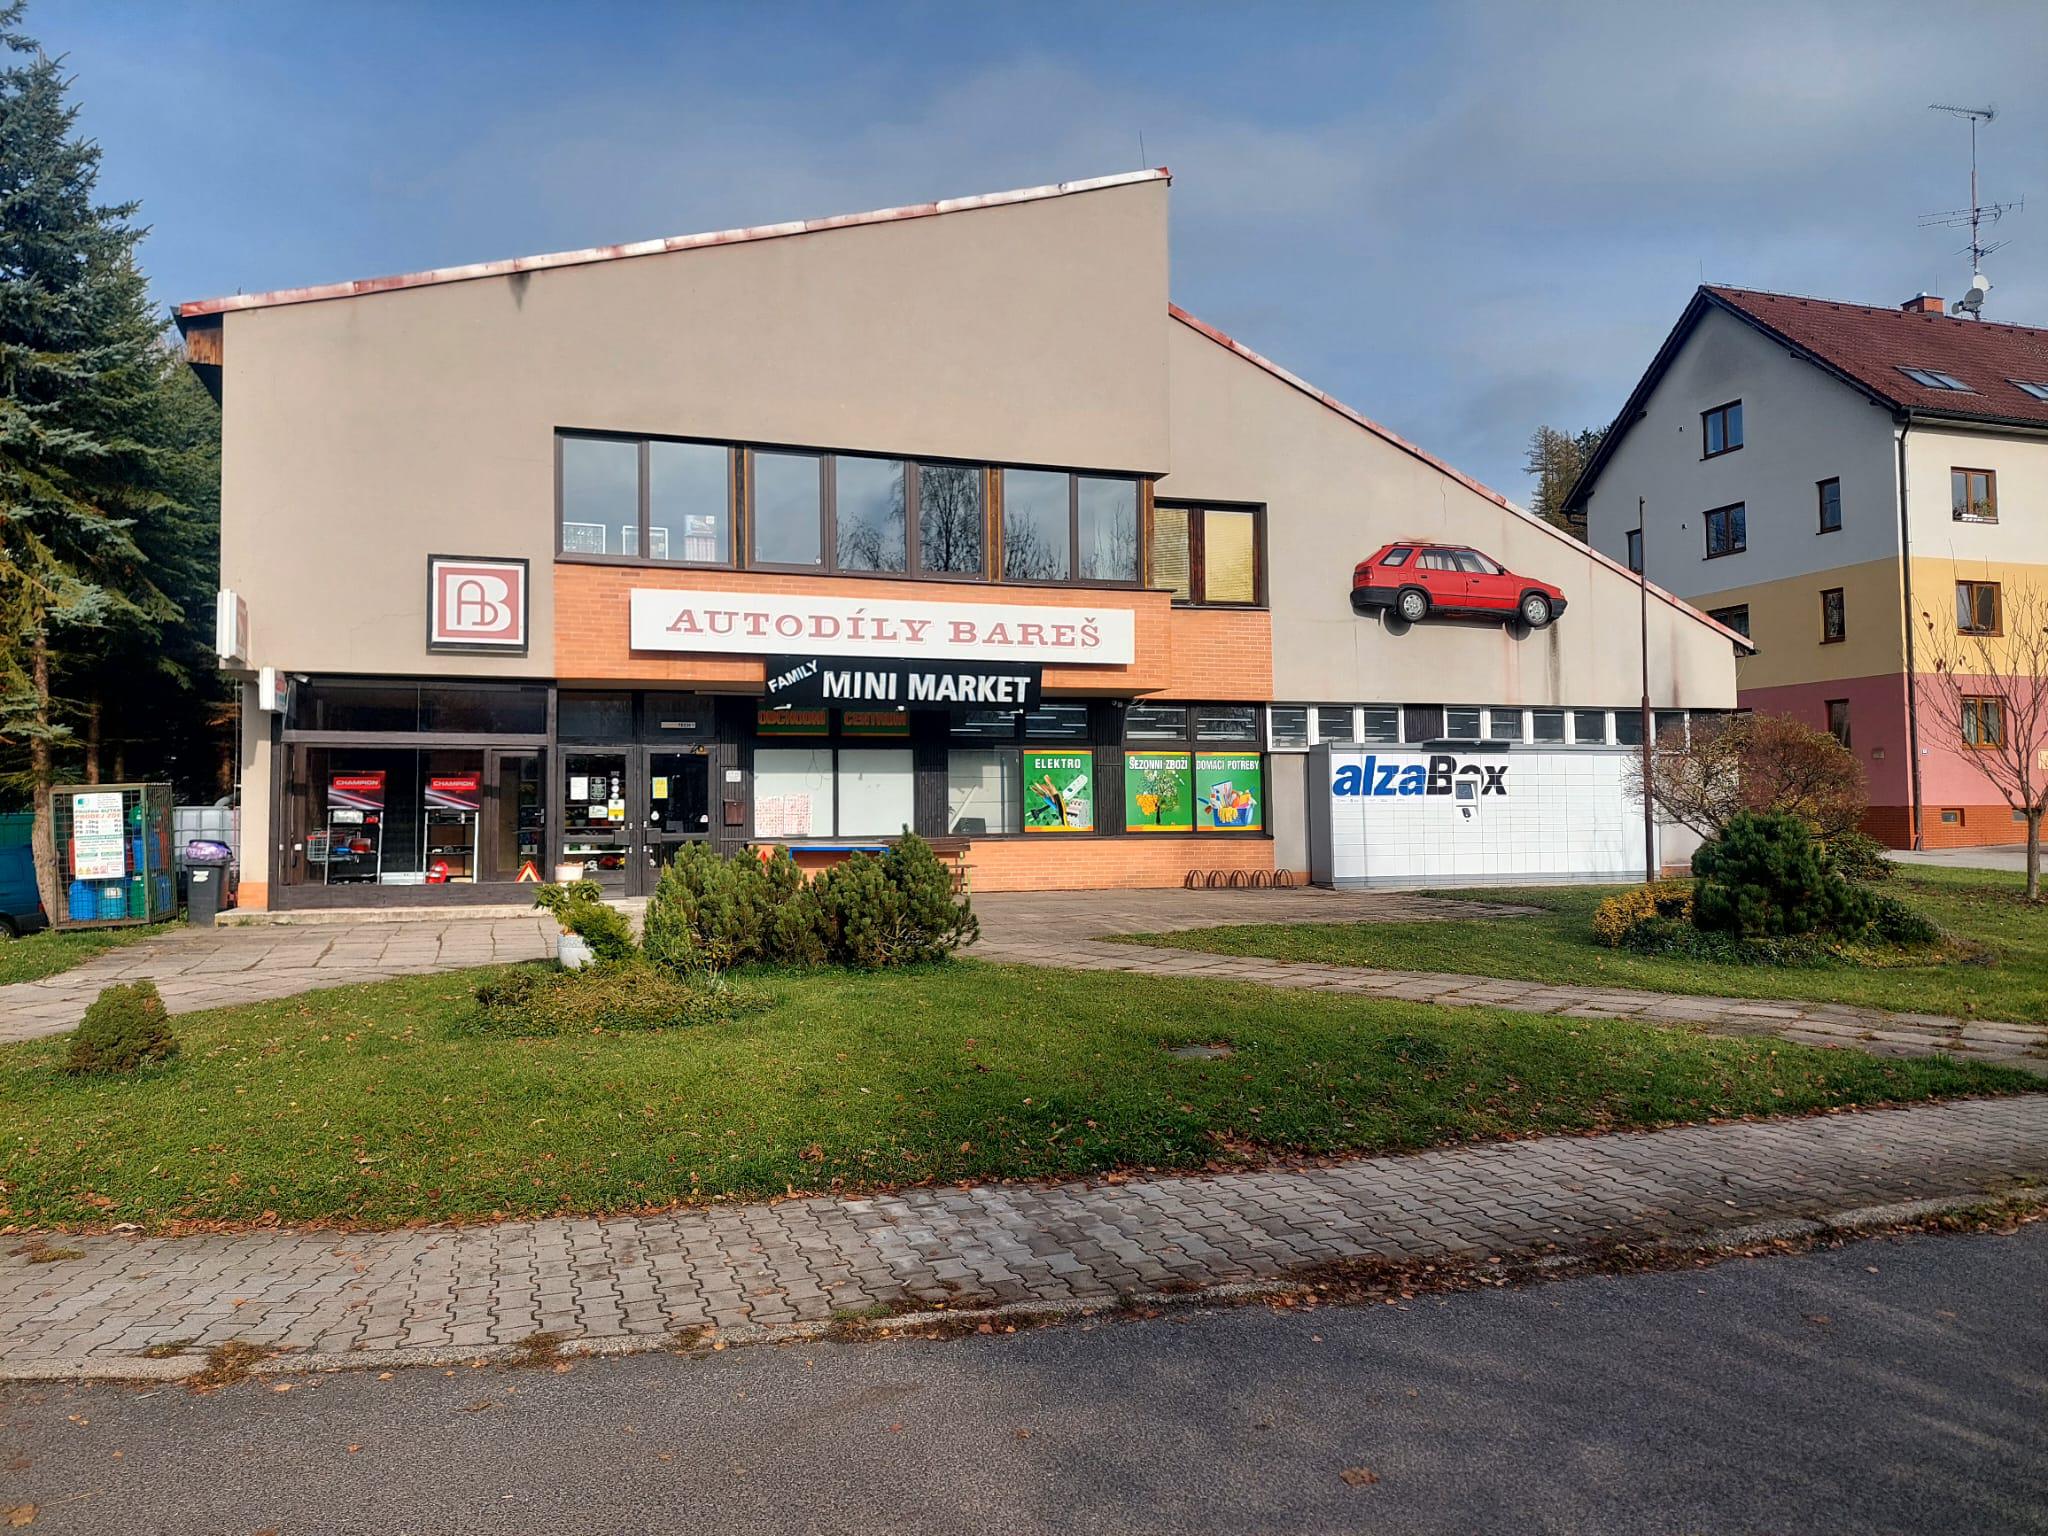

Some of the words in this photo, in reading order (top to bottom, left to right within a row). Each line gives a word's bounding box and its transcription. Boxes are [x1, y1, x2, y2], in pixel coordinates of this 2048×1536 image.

[666, 607, 931, 642] AUTODÍLY
[948, 617, 1101, 647] BAREŠ
[767, 659, 819, 693] FAMILY
[823, 671, 897, 700] MINI
[908, 673, 1031, 703] MARKET
[1035, 758, 1081, 769] ELEKTRO
[1228, 757, 1260, 770] POTŘEBY
